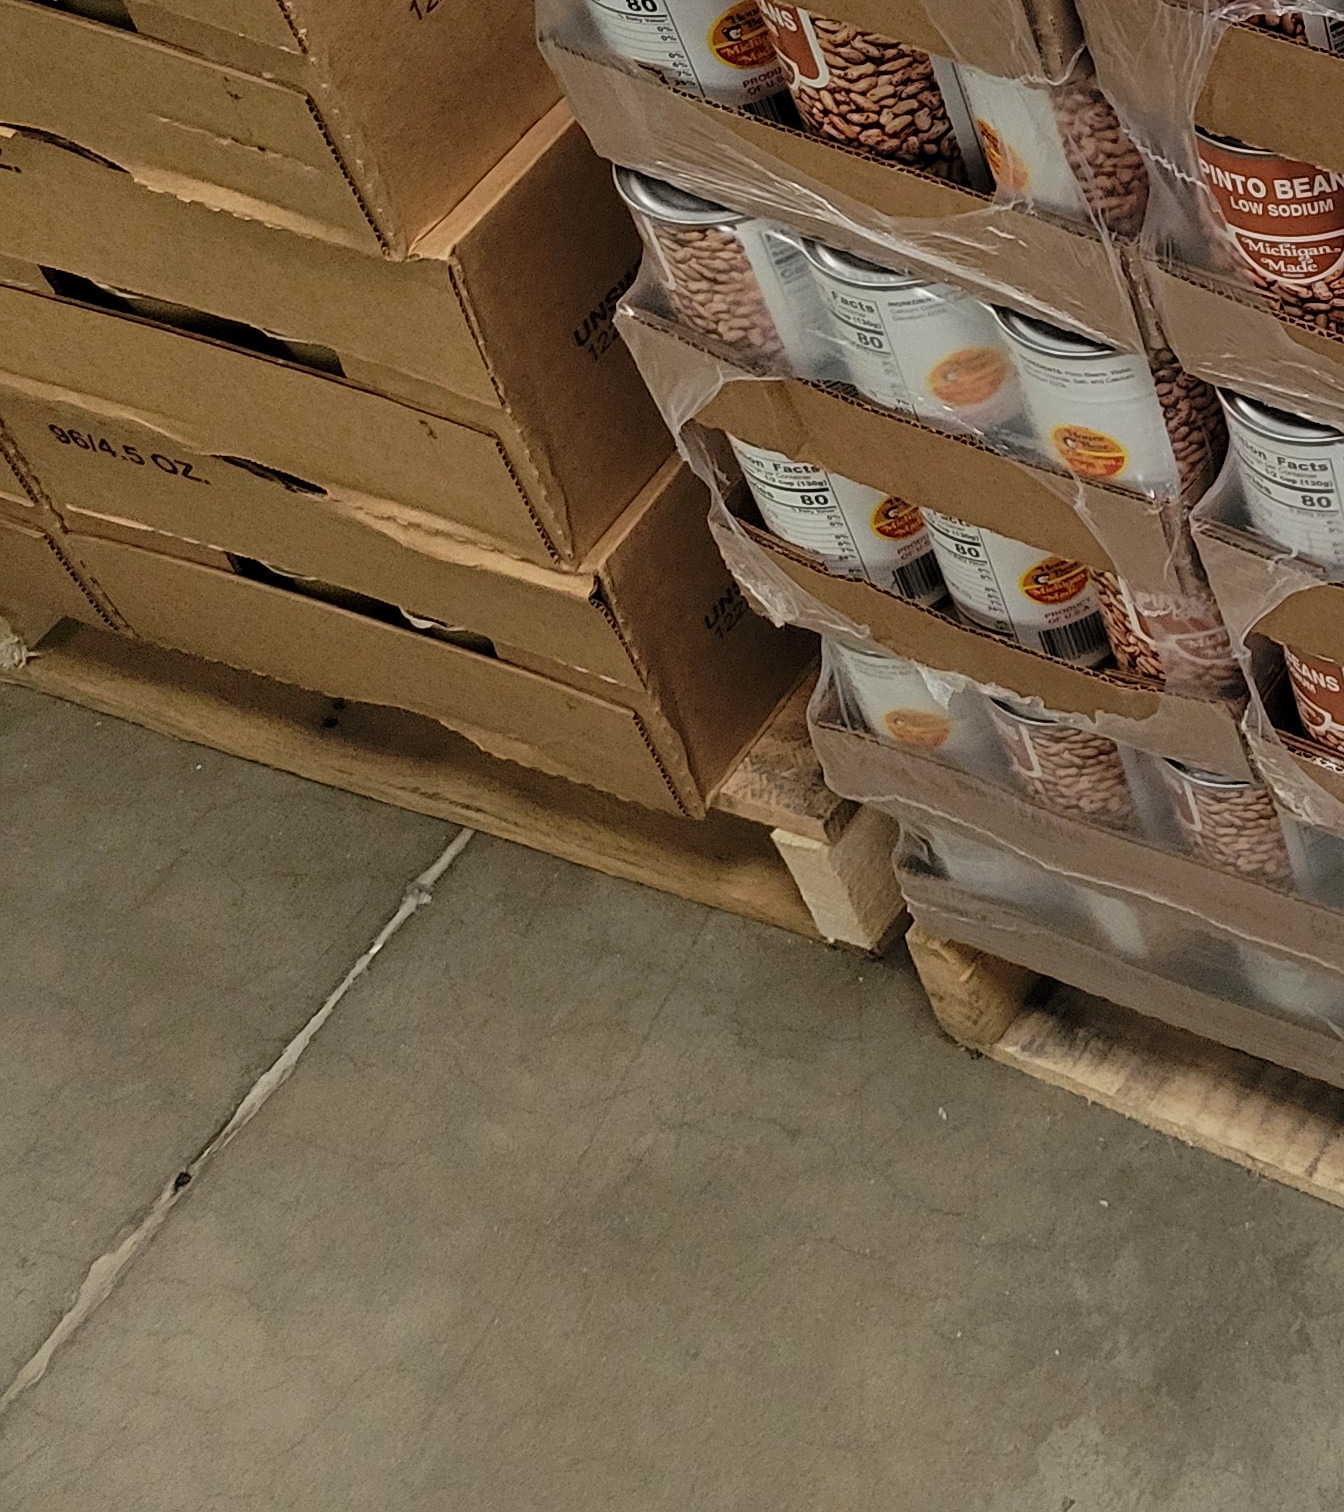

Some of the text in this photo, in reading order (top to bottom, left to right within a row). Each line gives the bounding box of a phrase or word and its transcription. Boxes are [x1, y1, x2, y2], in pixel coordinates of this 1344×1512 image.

[1230, 196, 1335, 217] LOW SODIUM
[1244, 236, 1333, 265] Michigan
[1266, 255, 1319, 276] Made
[46, 421, 212, 487] 96/4.5 OZ.
